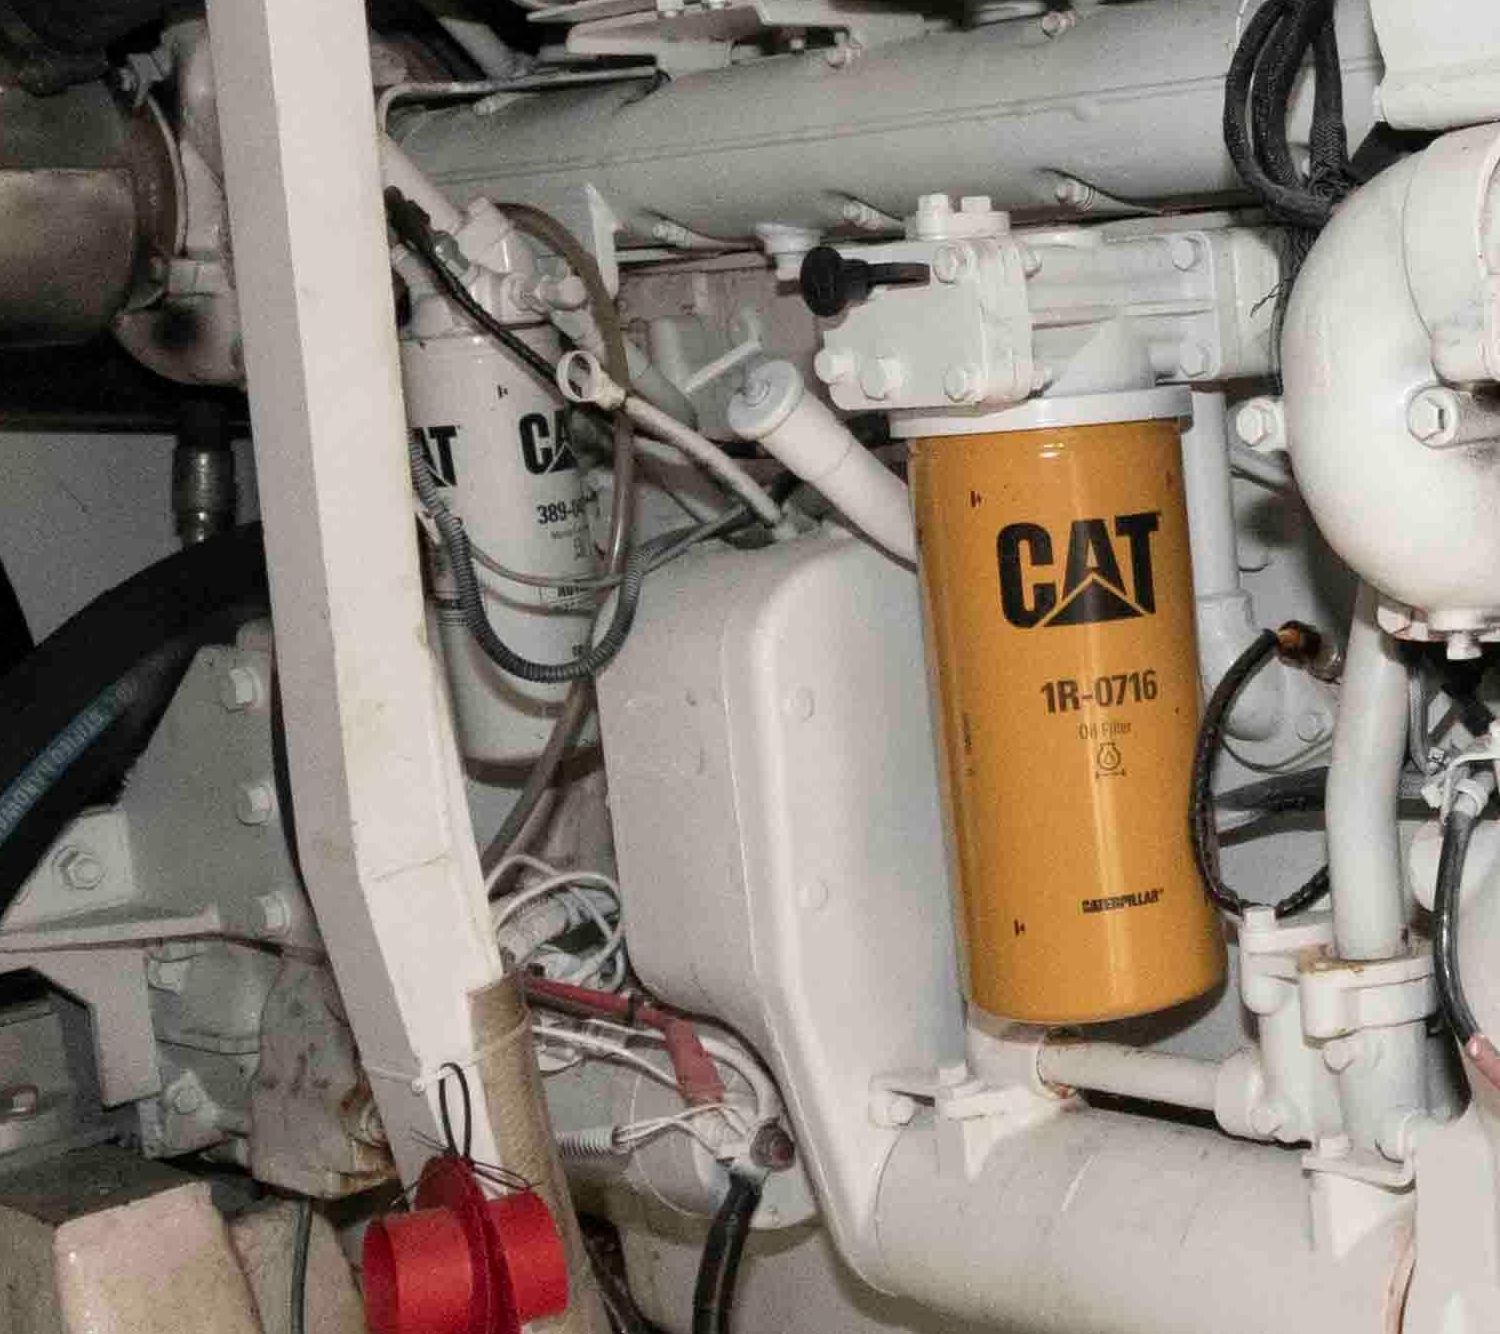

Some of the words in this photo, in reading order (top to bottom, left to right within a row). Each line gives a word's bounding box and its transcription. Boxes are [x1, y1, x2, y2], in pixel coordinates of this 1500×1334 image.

[411, 424, 458, 488] AT
[518, 412, 582, 475] CA
[996, 512, 1160, 628] CAT
[1040, 669, 1158, 714] 1R-0716
[1081, 888, 1159, 914] CATERPILLAR
